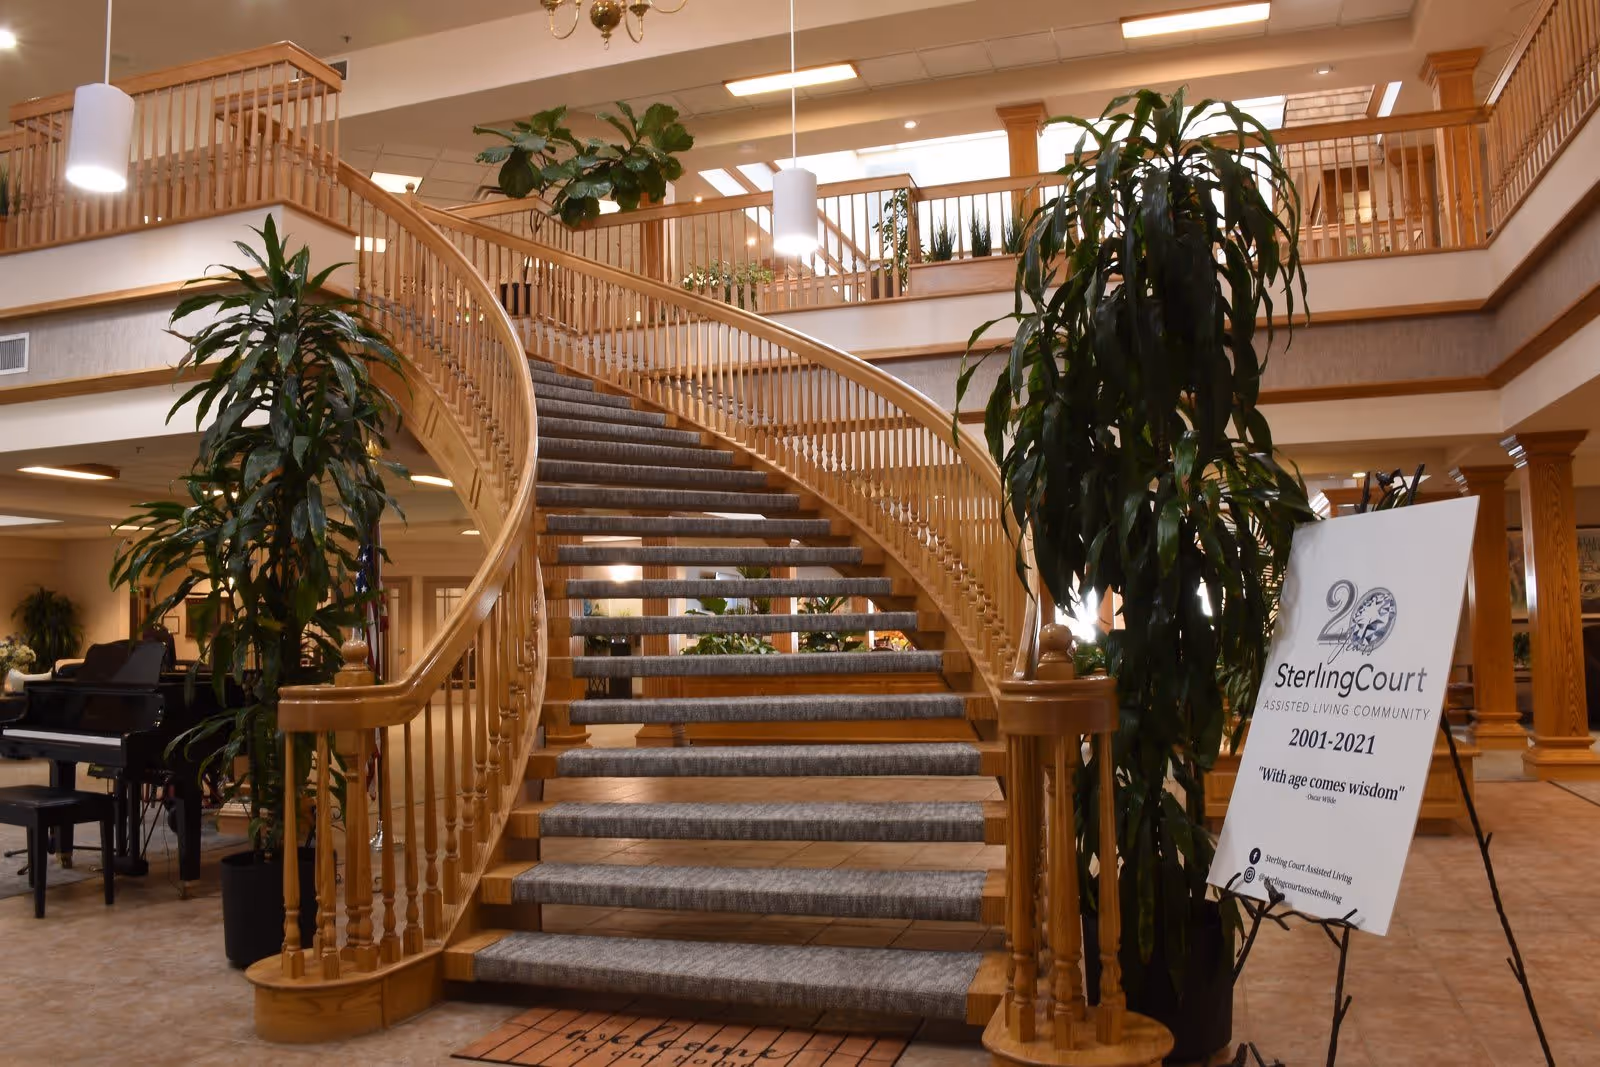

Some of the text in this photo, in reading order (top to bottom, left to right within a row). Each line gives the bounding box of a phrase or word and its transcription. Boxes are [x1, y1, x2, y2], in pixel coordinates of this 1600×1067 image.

[1317, 579, 1397, 652] 20
[1275, 662, 1427, 698] SterlingCourt
[1263, 699, 1430, 721] ASSISTED LIVING COMMUNITY
[1288, 727, 1376, 755] 2001-2021
[1258, 765, 1406, 801] "With age comes wisdom"
[1265, 854, 1288, 869] Sterling
[1288, 859, 1306, 871] Court
[1305, 864, 1332, 879] Assisted
[1332, 870, 1353, 885] Living
[565, 1024, 805, 1060] welcome
[610, 1050, 662, 1063] our
